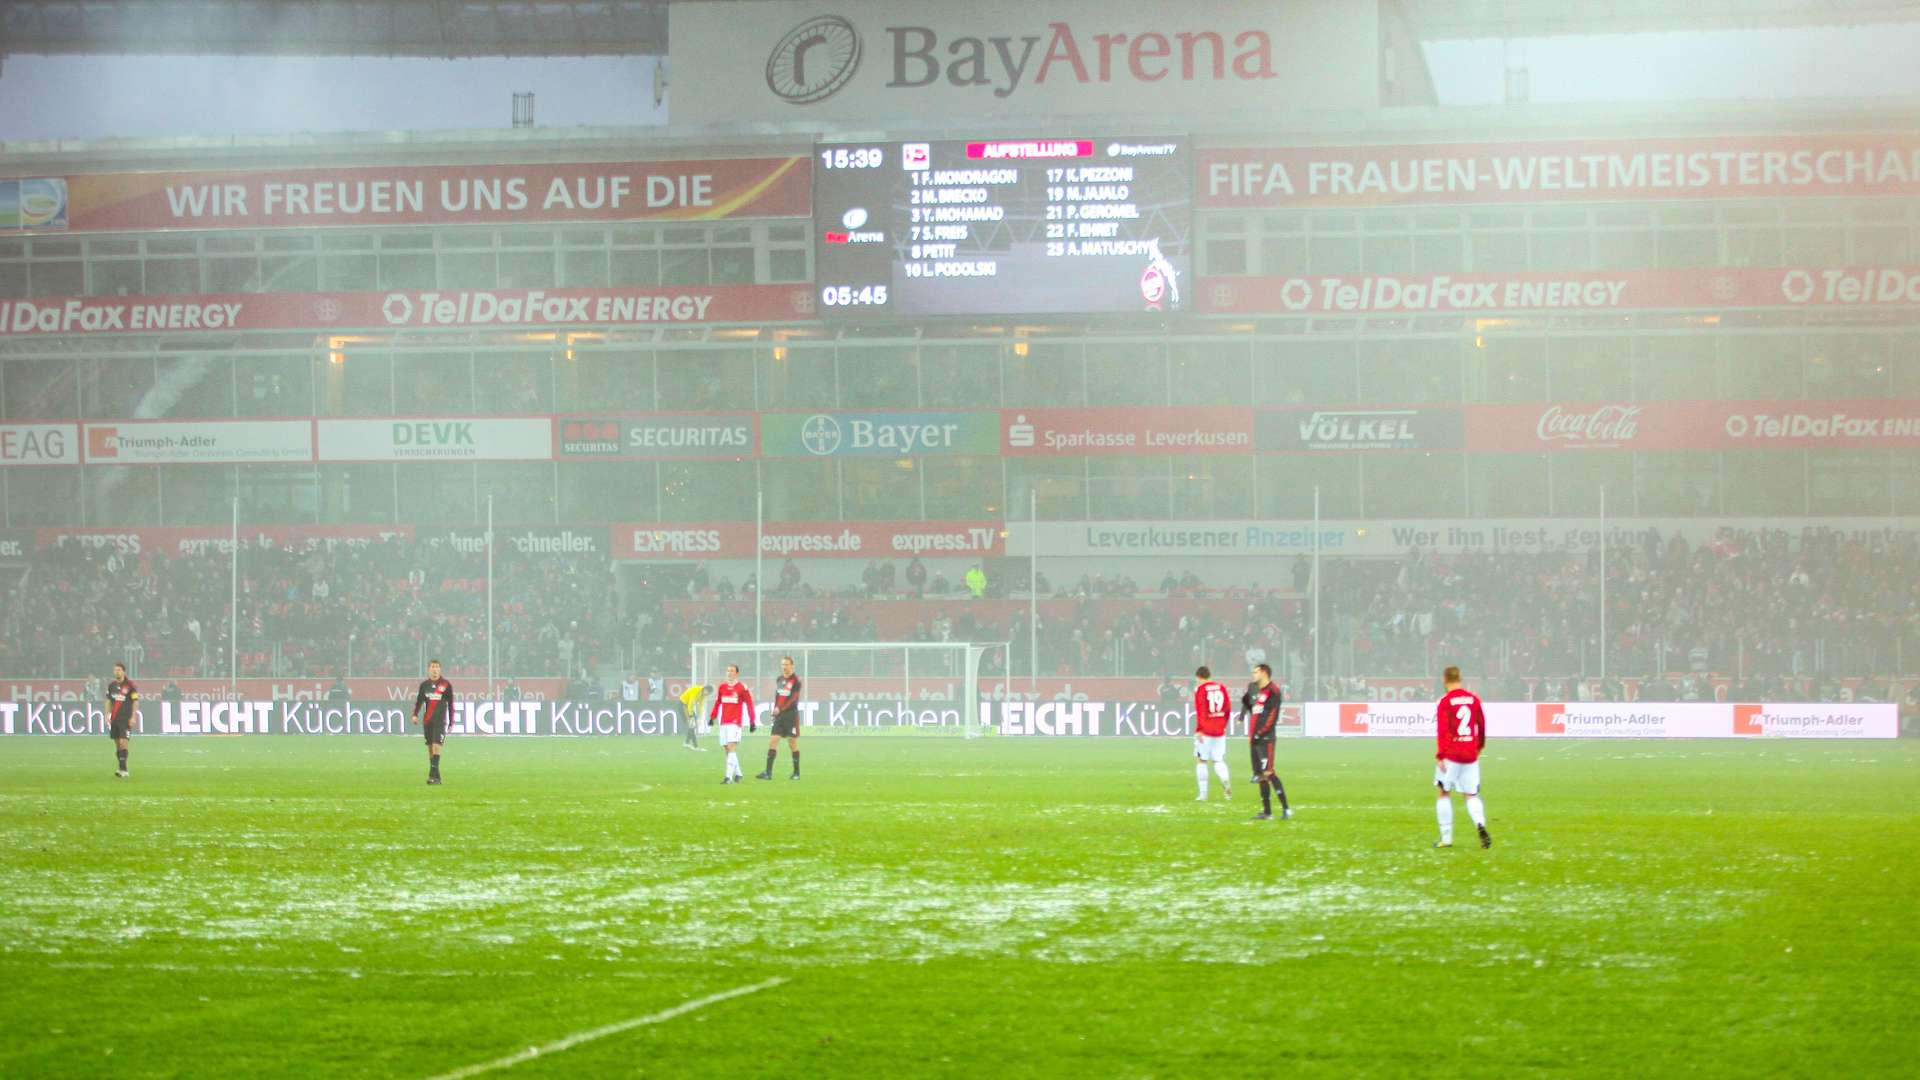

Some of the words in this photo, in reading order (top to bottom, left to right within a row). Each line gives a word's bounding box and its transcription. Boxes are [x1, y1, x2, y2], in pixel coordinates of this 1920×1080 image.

[885, 22, 1278, 98] BayArena
[822, 148, 883, 169] 15:39
[983, 142, 1078, 158] AUFSTELLUNG
[1047, 168, 1064, 183] 17
[1208, 162, 1295, 196] FIFA
[165, 183, 249, 218] WIR
[264, 179, 423, 215] FREUEN
[440, 177, 528, 212] UNS
[543, 176, 630, 210] AUF
[646, 174, 713, 209] DIE
[911, 190, 920, 204] 2
[1047, 187, 1064, 201] 19
[1046, 205, 1062, 219] 21
[911, 226, 920, 240] 7
[904, 263, 921, 277] 10
[823, 285, 887, 306] 05:45
[1320, 277, 1501, 311] TelDaFax
[1503, 280, 1628, 308] ENERGY
[130, 302, 243, 329] ENERGY
[420, 291, 591, 324] TelDaFax
[596, 295, 713, 322] ENERGY
[392, 422, 475, 446] DEVK
[629, 427, 747, 447] SECURITAS
[850, 420, 959, 453] Bayer
[1298, 411, 1416, 441] VÖLKEL
[1753, 414, 1879, 438] TelDaFax
[118, 435, 217, 450] Triumph-Adler
[564, 442, 619, 453] SECURITAS
[1044, 429, 1136, 450] Sparkasse
[1145, 428, 1248, 447] Leverkusen
[633, 530, 720, 553] EXPRESS
[760, 529, 861, 554] express.de
[892, 528, 994, 553] express.TV
[1087, 527, 1238, 548] Leverkusener
[1245, 527, 1345, 551] Anzeiger
[1392, 527, 1439, 546] Wer
[1448, 527, 1484, 546] ihn
[161, 702, 273, 734] LEICHT
[282, 702, 405, 734] Küchen
[427, 702, 541, 734] EICHT
[551, 702, 678, 734] Küchen
[829, 701, 960, 727] Küchen
[1115, 702, 1248, 735] Küchn
[1456, 705, 1472, 736] 2
[1565, 713, 1666, 726] Triumph-Adler
[1763, 714, 1864, 727] Triumph-Adler
